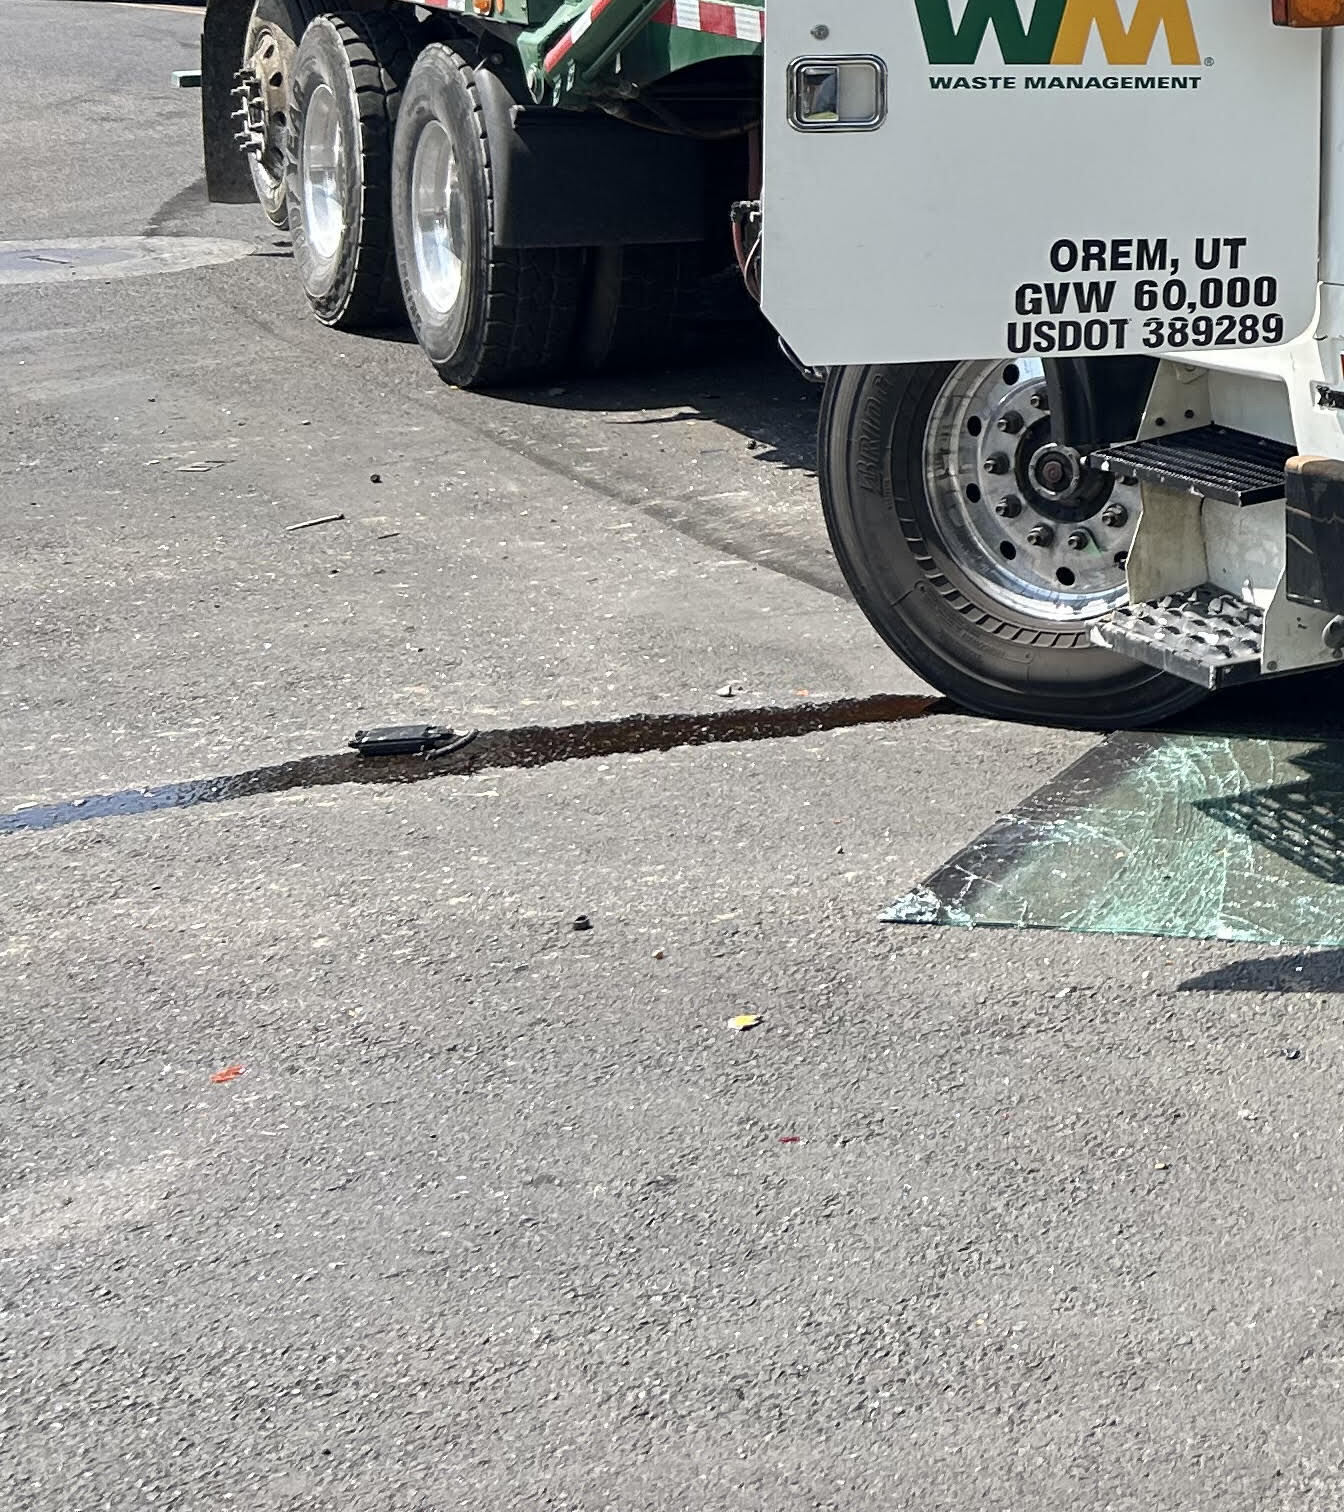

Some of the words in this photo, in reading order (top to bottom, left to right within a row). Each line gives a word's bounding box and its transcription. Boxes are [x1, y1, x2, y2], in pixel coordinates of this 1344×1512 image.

[929, 76, 1017, 90] WASTE
[1024, 76, 1202, 90] MANAGEMENT
[1050, 238, 1180, 276] OREM,
[1194, 237, 1247, 270] UT
[1015, 280, 1117, 316] GVW
[1133, 276, 1278, 314] 60,000
[1007, 318, 1129, 353] USDOT
[1142, 313, 1284, 349] 389289
